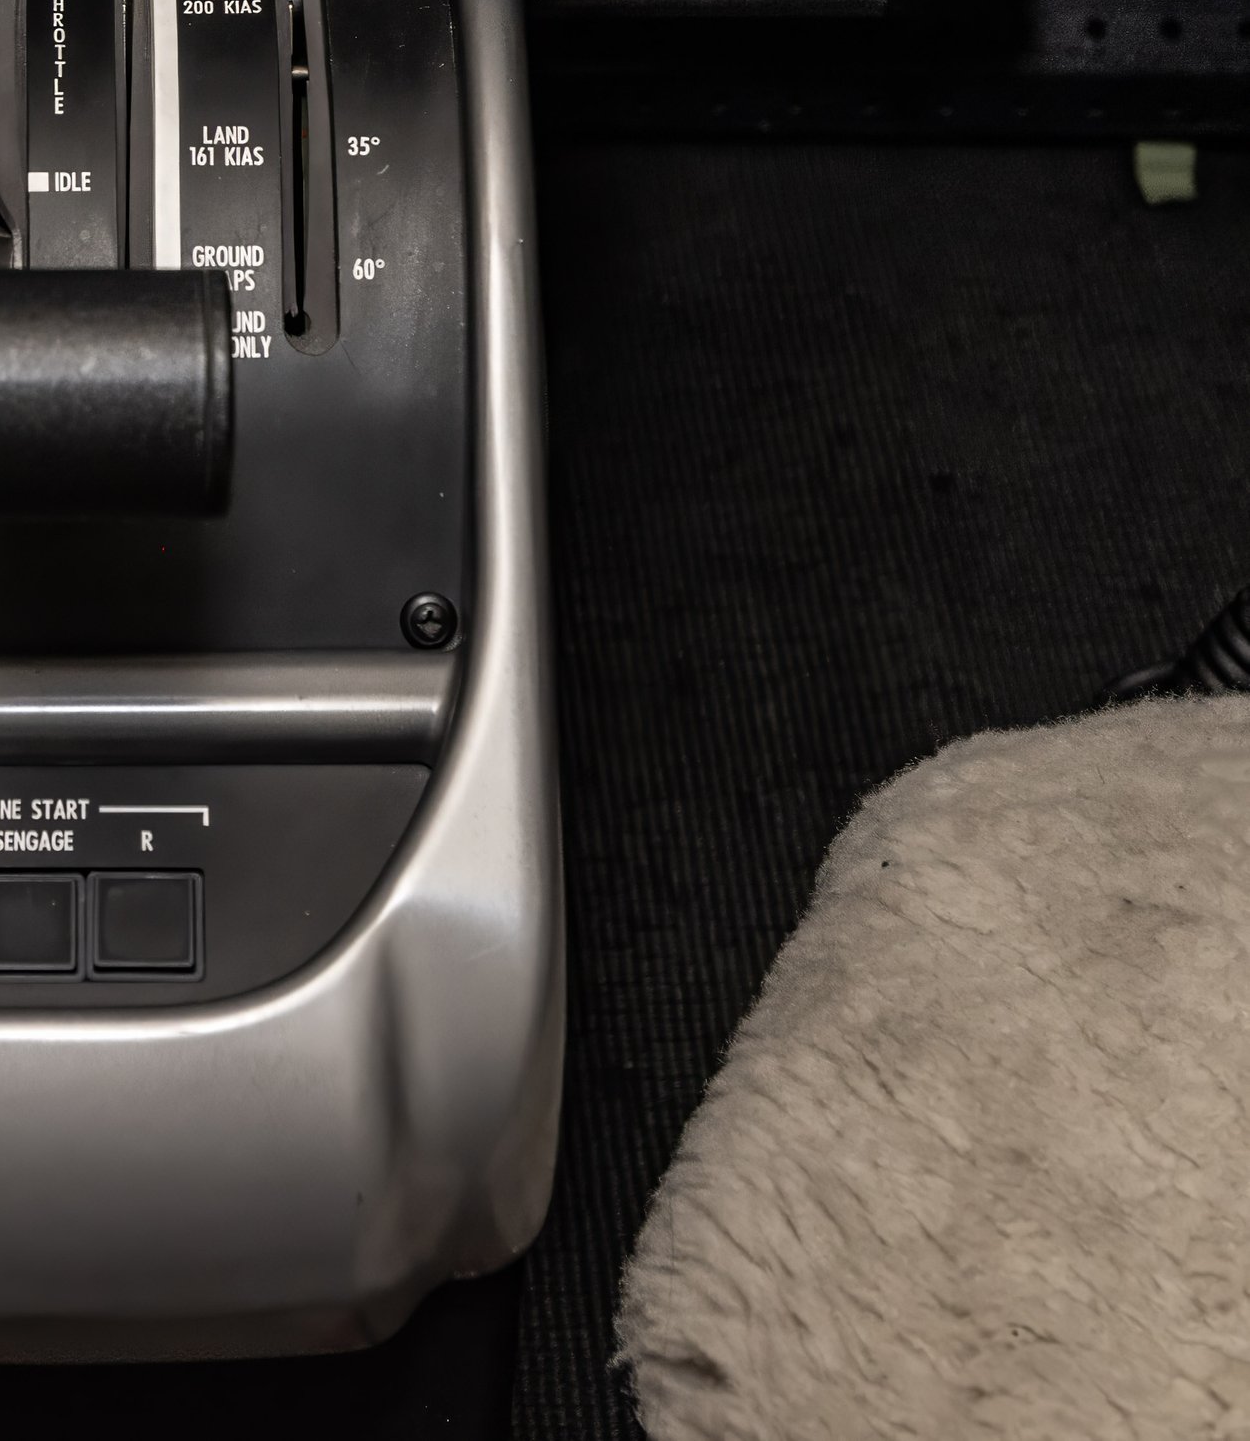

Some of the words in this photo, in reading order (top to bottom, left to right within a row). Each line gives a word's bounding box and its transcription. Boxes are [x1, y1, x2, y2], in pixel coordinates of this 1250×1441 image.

[183, 0, 214, 15] 200
[224, 0, 263, 14] KIAS
[203, 126, 249, 145] LAND
[190, 148, 215, 166] 161
[224, 147, 264, 166] KIAS
[348, 137, 381, 156] 35°
[192, 246, 264, 267] GROUND
[353, 259, 385, 280] 60°
[31, 799, 90, 821] START
[141, 830, 153, 852] R
